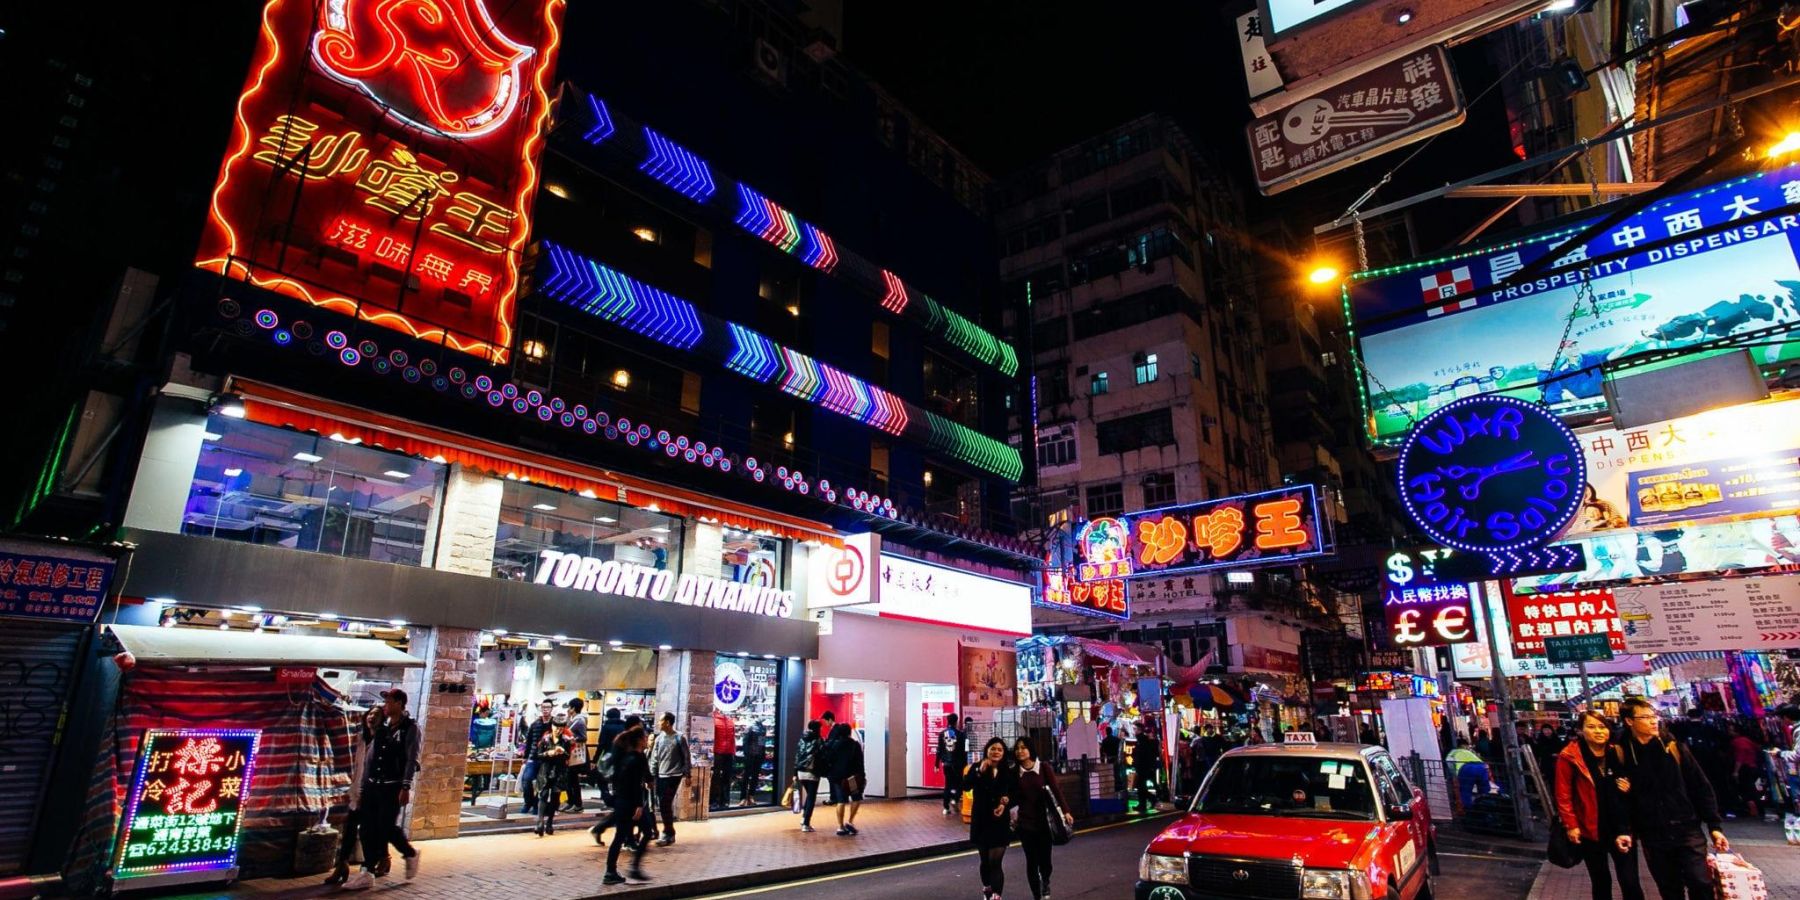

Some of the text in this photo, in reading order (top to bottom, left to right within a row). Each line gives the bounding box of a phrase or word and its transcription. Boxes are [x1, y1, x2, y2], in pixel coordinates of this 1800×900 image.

[1337, 87, 1409, 110] 汽車晶片匙
[1402, 53, 1443, 113] 祥發
[1310, 104, 1328, 136] KEY
[1254, 119, 1285, 171] 配匙
[330, 219, 494, 295] 滋味無界
[1647, 212, 1800, 263] DISPENSAR
[1408, 472, 1480, 538] Hair
[1486, 453, 1572, 541] Salon
[1139, 498, 1307, 565] 沙嗲王
[533, 549, 796, 618] TORONTO DYNAMICS
[1163, 589, 1201, 599] HOTEL
[1385, 584, 1469, 606] 人民幣找換
[1523, 600, 1615, 620] 特快國內人
[1550, 636, 1604, 648] TAXI STAND
[1286, 733, 1312, 742] TAXI
[146, 836, 233, 856] 62433843
